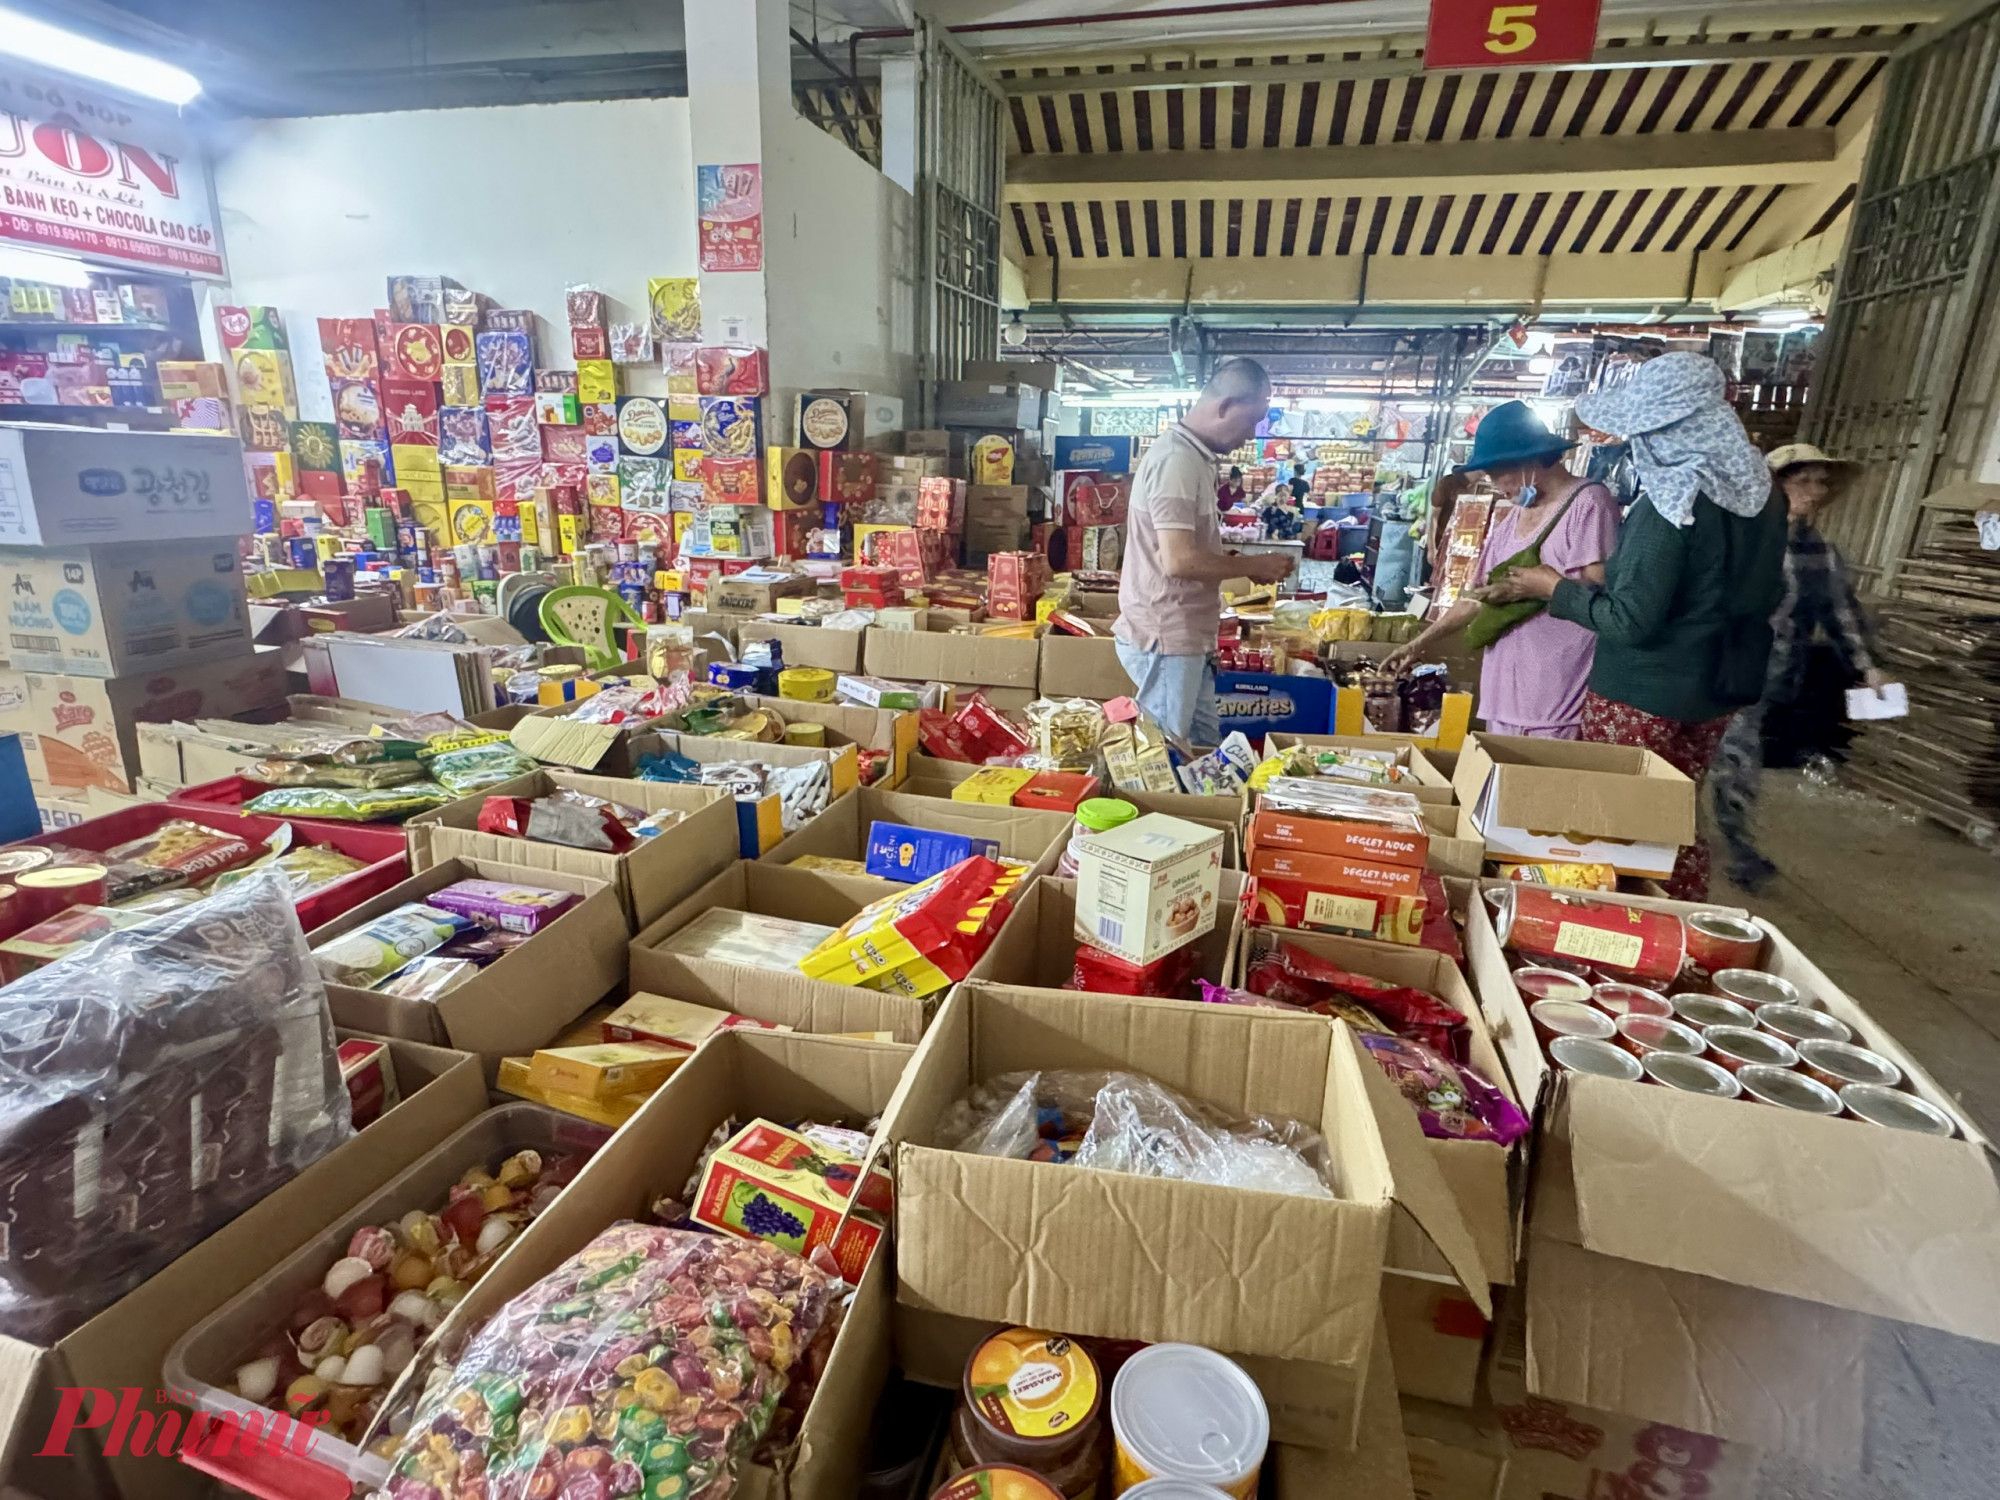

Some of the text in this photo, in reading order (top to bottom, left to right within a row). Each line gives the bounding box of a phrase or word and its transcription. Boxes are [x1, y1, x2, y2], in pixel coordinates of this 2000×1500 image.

[1484, 5, 1538, 54] 5
[96, 205, 158, 235] CHOCOLA
[161, 220, 186, 242] CAO
[1234, 682, 1269, 692] KIRKLAND
[884, 834, 897, 869] VICENI
[1345, 833, 1416, 852] DEGLET NOUR
[1342, 865, 1411, 883] DEGLET NOUR
